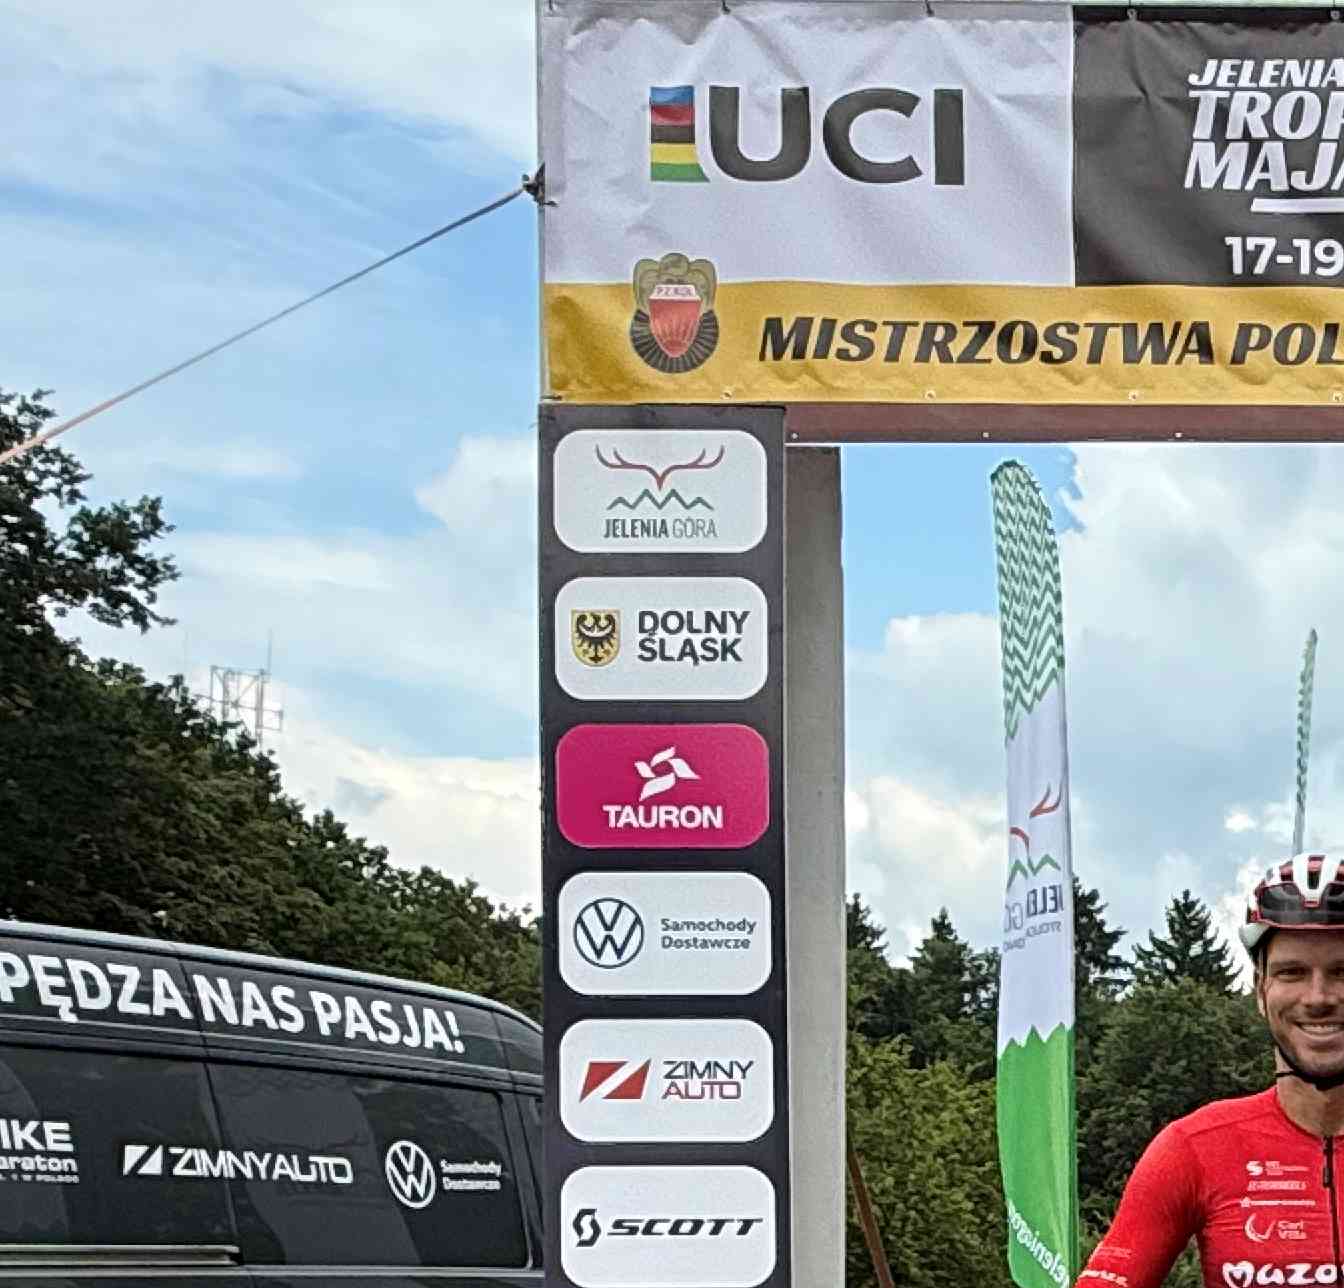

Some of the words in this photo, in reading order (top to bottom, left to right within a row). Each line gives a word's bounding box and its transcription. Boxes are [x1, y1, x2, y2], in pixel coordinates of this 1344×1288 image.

[709, 85, 965, 186] UCI
[758, 316, 1216, 366] MISTRZOSTWA
[603, 518, 669, 539] JELENIA
[672, 514, 718, 538] GÓRA
[637, 610, 751, 635] DOLNY
[637, 633, 743, 666] ŚLĄSK
[602, 804, 723, 829] TAURON
[660, 917, 757, 935] Samochody
[660, 935, 751, 950] Dostawcze
[192, 974, 306, 1034] NAS
[307, 989, 466, 1054] PASJA!
[663, 1060, 754, 1080] ZIMNY
[661, 1080, 742, 1100] AUTO
[607, 1219, 763, 1237] SCOTT
